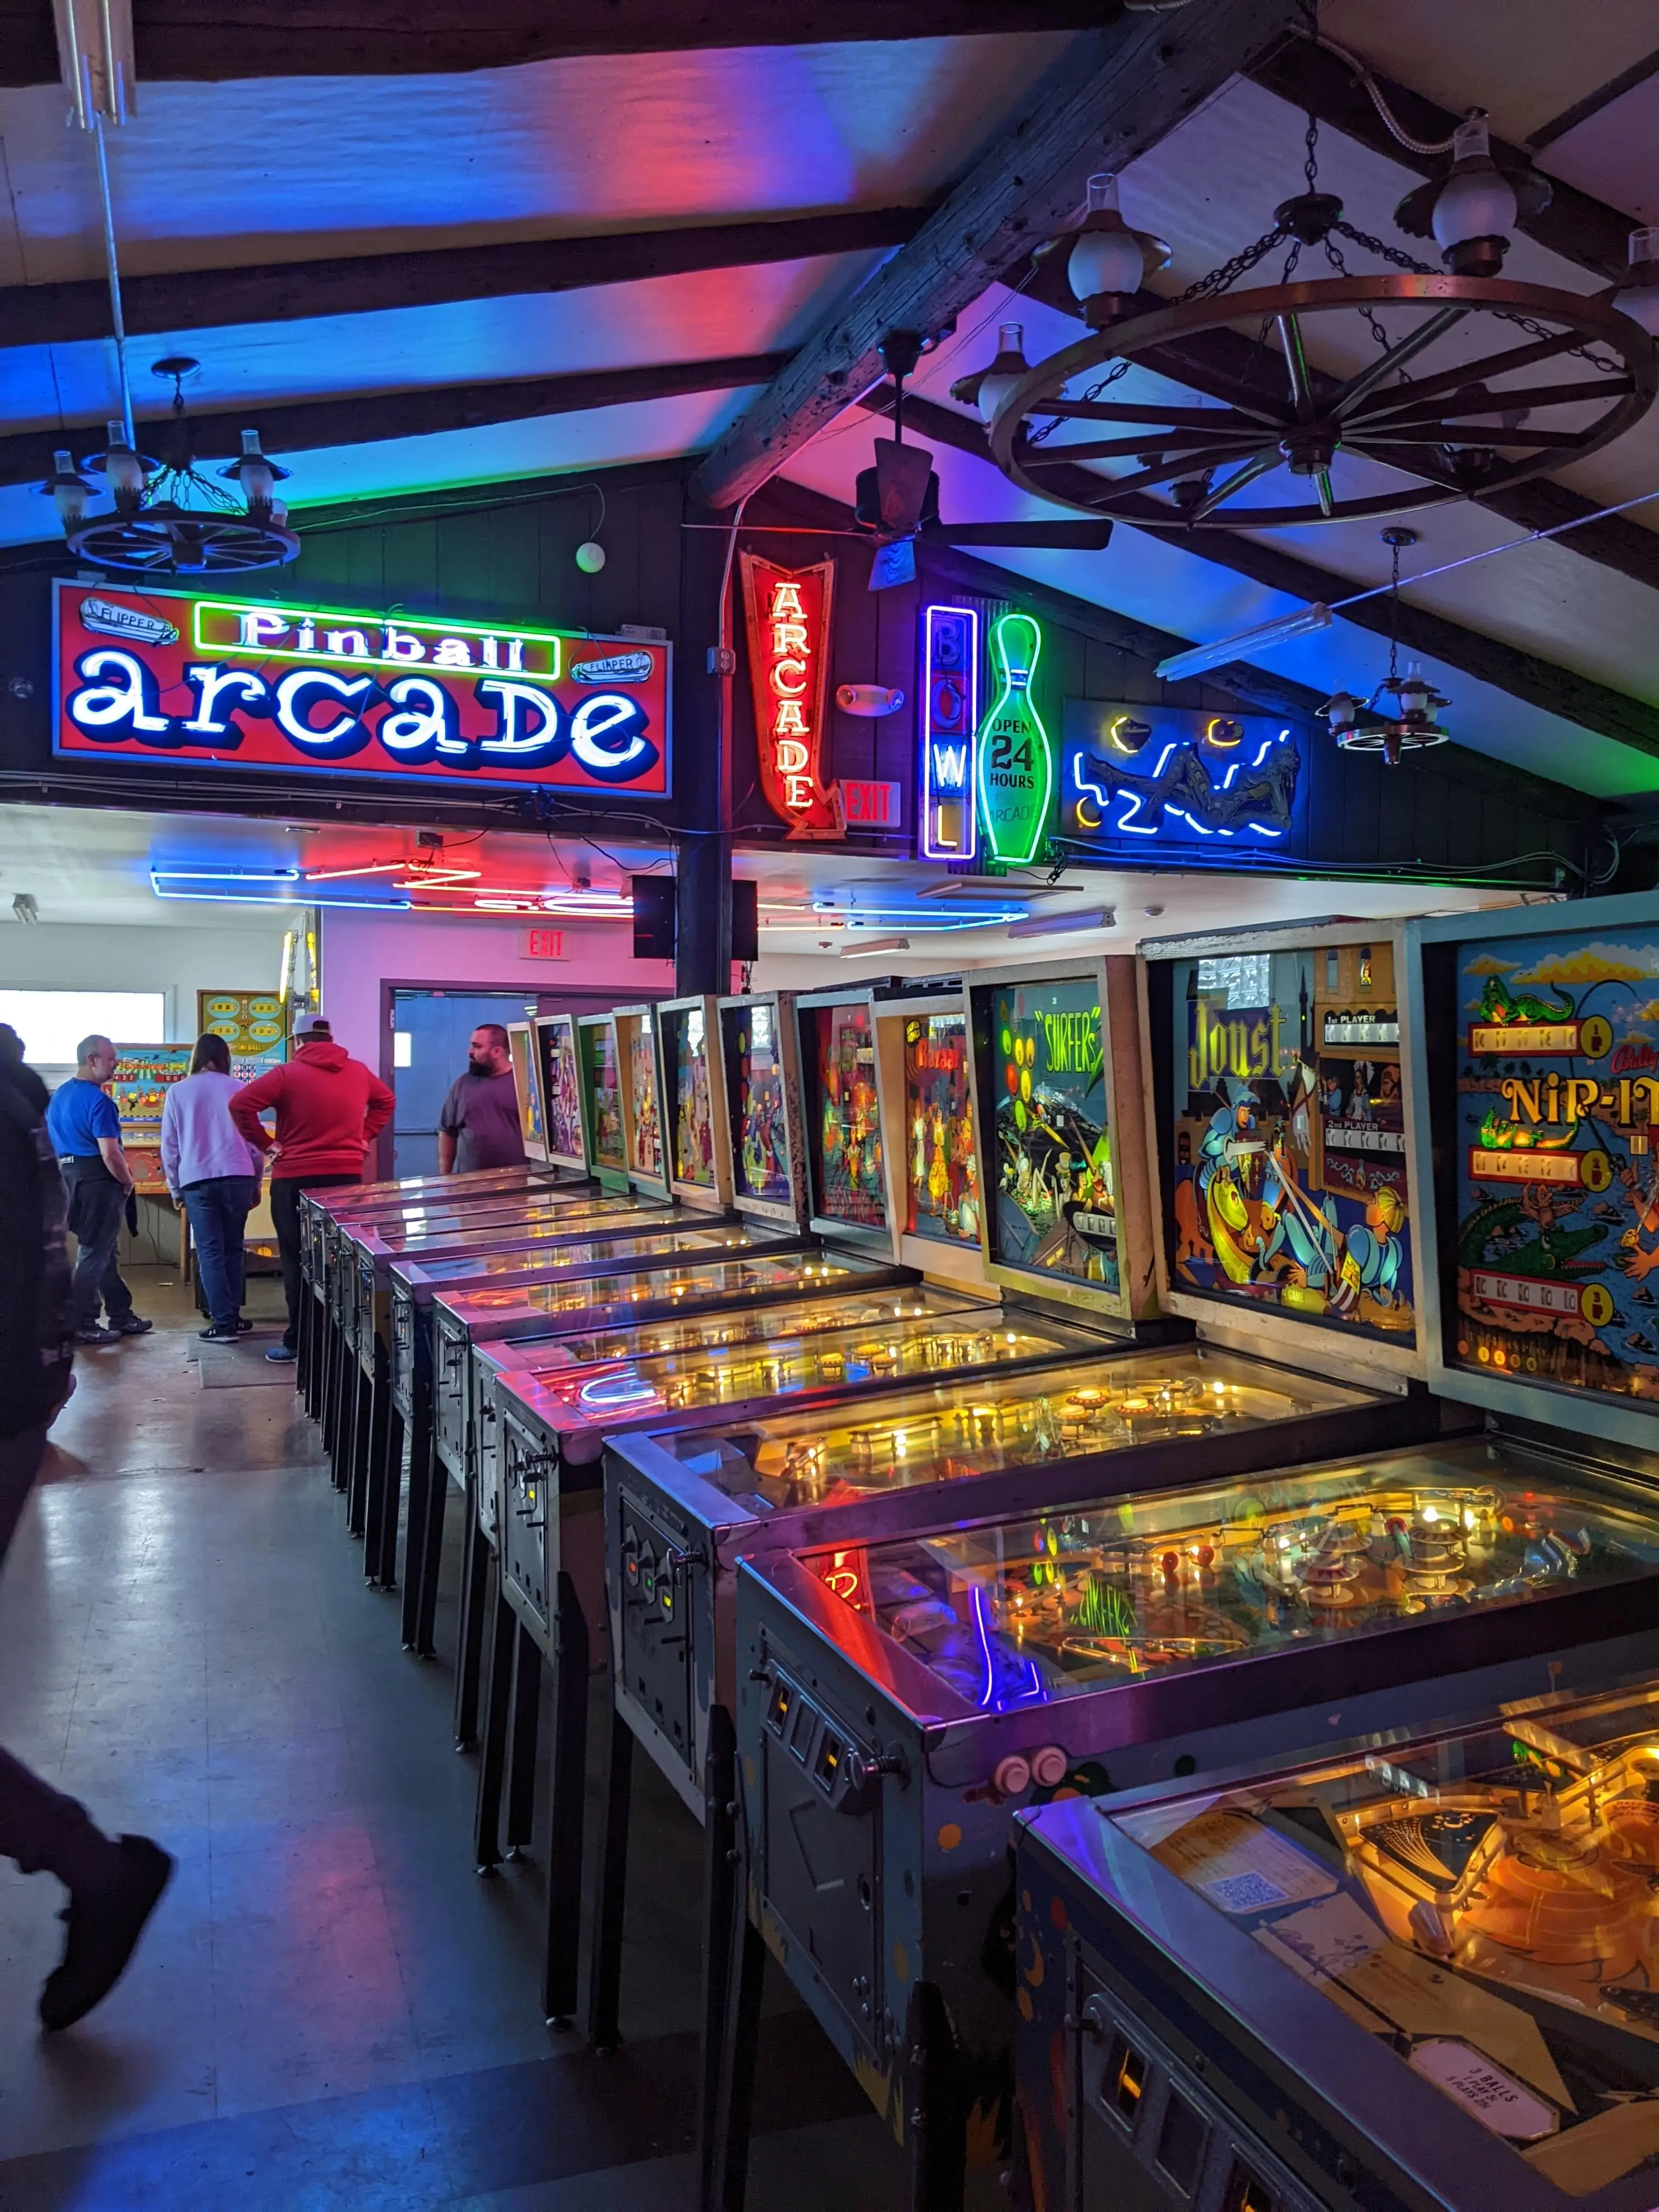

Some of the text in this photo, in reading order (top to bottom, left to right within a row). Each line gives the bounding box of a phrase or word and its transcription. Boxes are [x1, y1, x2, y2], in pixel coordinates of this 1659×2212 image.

[101, 607, 154, 629] FLIPPER
[235, 611, 527, 673] Pinball
[771, 583, 814, 808] ARCADE
[931, 620, 967, 848] BOWL
[992, 718, 1031, 734] OPEN
[991, 735, 1035, 772] 24
[990, 772, 1034, 789] HOURS
[846, 783, 890, 822] EXIT
[529, 929, 564, 957] EXIT
[1340, 1015, 1376, 1024] PLAYER
[917, 1037, 960, 1070] Bazaar
[1188, 1000, 1288, 1090] Joust
[1611, 1045, 1658, 1074] Bally
[1328, 1120, 1378, 1131] 2nd PLAYER
[1288, 1289, 1304, 1302] GAME
[1453, 2081, 1479, 2098] PLAYS
[1468, 2080, 1491, 2094] PLAY
[1480, 2075, 1519, 2103] BALLS
